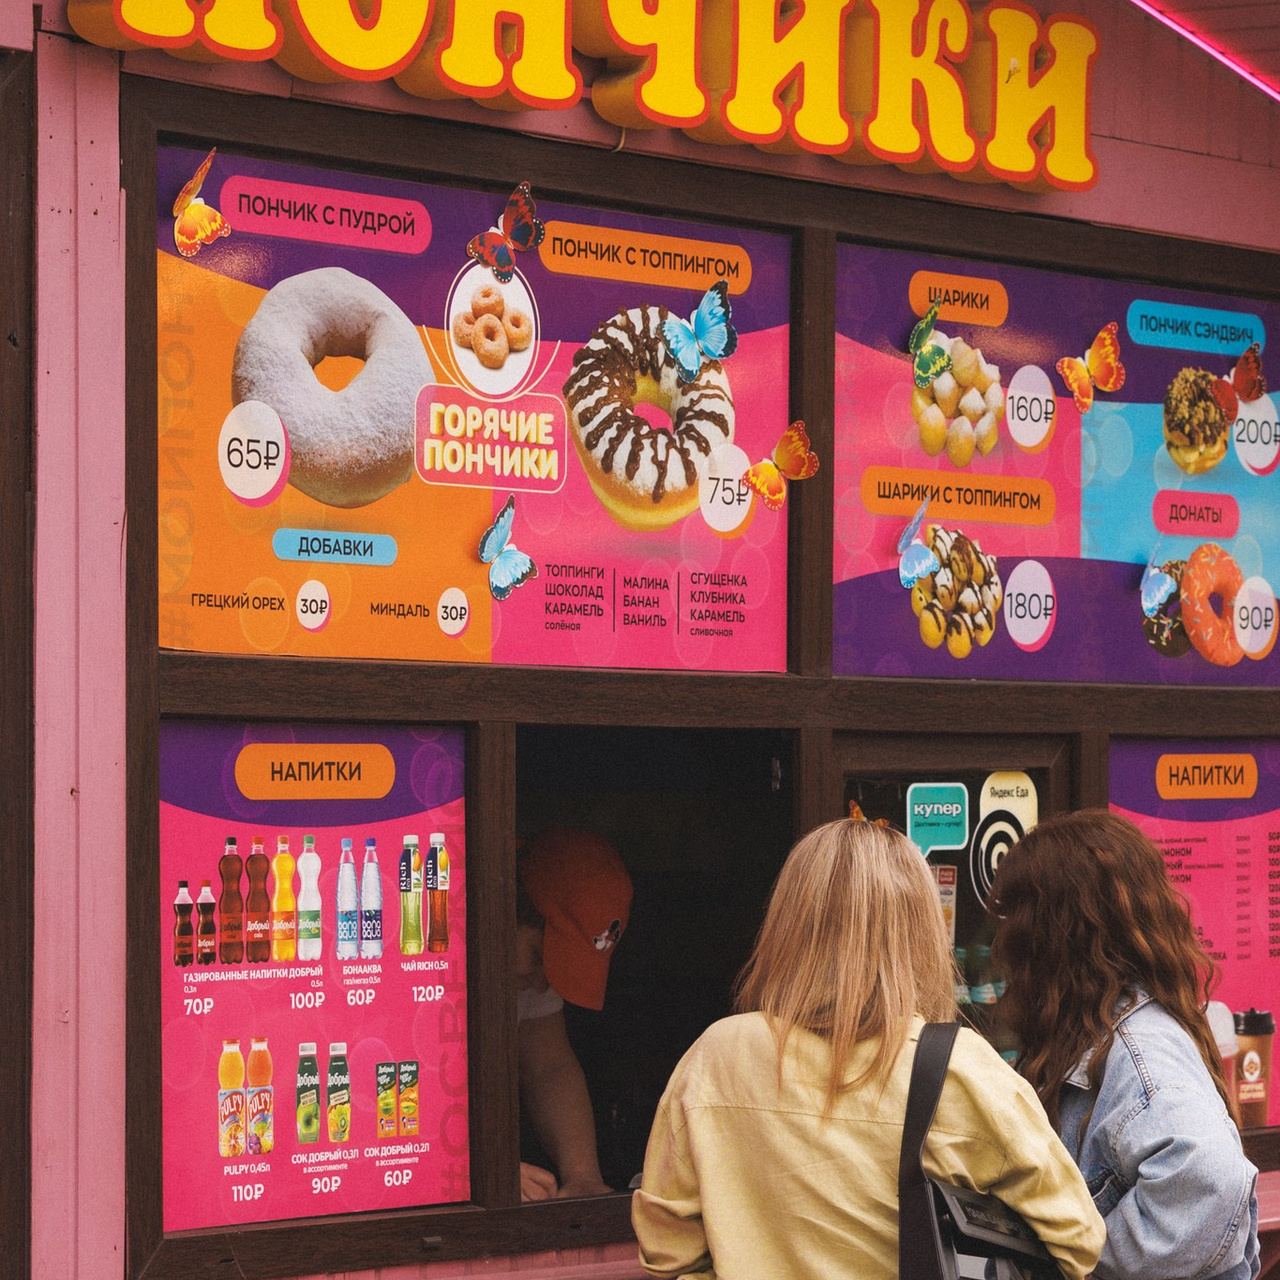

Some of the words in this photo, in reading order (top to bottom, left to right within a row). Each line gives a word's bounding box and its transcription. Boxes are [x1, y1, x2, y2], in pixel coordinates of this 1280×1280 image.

[238, 193, 318, 223] ПОНЧИК
[322, 205, 335, 225] С
[339, 207, 415, 236] ПУДРОЙ
[552, 236, 622, 264] ПОНЧИК
[625, 246, 637, 266] С
[640, 249, 740, 278] ТОППИНГОМ
[928, 286, 989, 311] ШАРИКИ
[1139, 314, 1192, 337] ПОНЧИК
[1194, 321, 1253, 344] СЭНДВИЧ
[1008, 395, 1055, 423] 160₽
[428, 402, 555, 445] ГОРЯЧИЕ
[227, 437, 280, 470] 65₽
[423, 439, 559, 480] ПОНЧИКИ
[708, 477, 750, 507] 75₽
[877, 481, 940, 503] ШАРИКИ
[943, 487, 953, 504] С
[956, 488, 1041, 510] ТОППИНГОМ
[1169, 504, 1222, 524] ДОНАТЫ
[298, 536, 374, 557] ДОБАВКИ
[545, 564, 605, 580] ТОППИНГИ
[690, 572, 748, 588] СГУЩЕНКА
[545, 583, 604, 600] ШОКОЛАД
[623, 577, 669, 591] МАЛИНА
[191, 592, 249, 611] ГРЕЦКИЙ
[252, 596, 285, 611] ОРЕХ
[300, 598, 328, 615] 30₽
[623, 595, 660, 608] БАНАН
[690, 591, 746, 605] КЛУБНИКА
[1006, 593, 1055, 620] 180₽
[370, 603, 430, 619] МИНДАЛЬ
[441, 605, 467, 621] 30₽
[545, 602, 604, 617] КАРАМЕЛЬ
[690, 608, 745, 623] КАРАМЕЛЬ
[1239, 606, 1274, 630] 90₽
[545, 620, 581, 631] солёная
[623, 613, 667, 627] ВАНИЛЬ
[690, 627, 733, 637] сливочная
[271, 761, 361, 782] НАПИТКИ
[1169, 766, 1244, 786] НАПИТКИ
[990, 787, 1014, 798] Яндекс
[1016, 786, 1029, 798] Еда
[914, 803, 962, 818] купер
[247, 920, 269, 931] Добрый
[184, 970, 248, 982] ГАЗИРОВАННЫЕ
[250, 968, 288, 979] НАПИТКИ
[289, 965, 323, 978] ДОБРЫЙ
[343, 964, 382, 975] БОНААКВА
[401, 961, 416, 971] ЧАЙ
[417, 961, 433, 970] RICH
[434, 960, 448, 970] 0,5л
[289, 992, 325, 1009] 100₽
[347, 989, 375, 1006] 60₽
[412, 985, 444, 1002] 120₽
[184, 998, 214, 1015] 70₽
[221, 1094, 242, 1121] PULPY
[249, 1092, 270, 1120] PULPY
[292, 1153, 308, 1164] СОК
[309, 1149, 341, 1164] ДОБРЫЙ
[364, 1146, 380, 1157] СОК
[381, 1142, 413, 1156] ДОБРЫЙ
[224, 1164, 248, 1175] PULPY
[308, 1163, 348, 1173] ассортименте
[380, 1156, 419, 1166] ассортименте
[312, 1176, 341, 1194] 90₽
[384, 1169, 412, 1187] 60₽
[232, 1183, 264, 1202] 110₽
